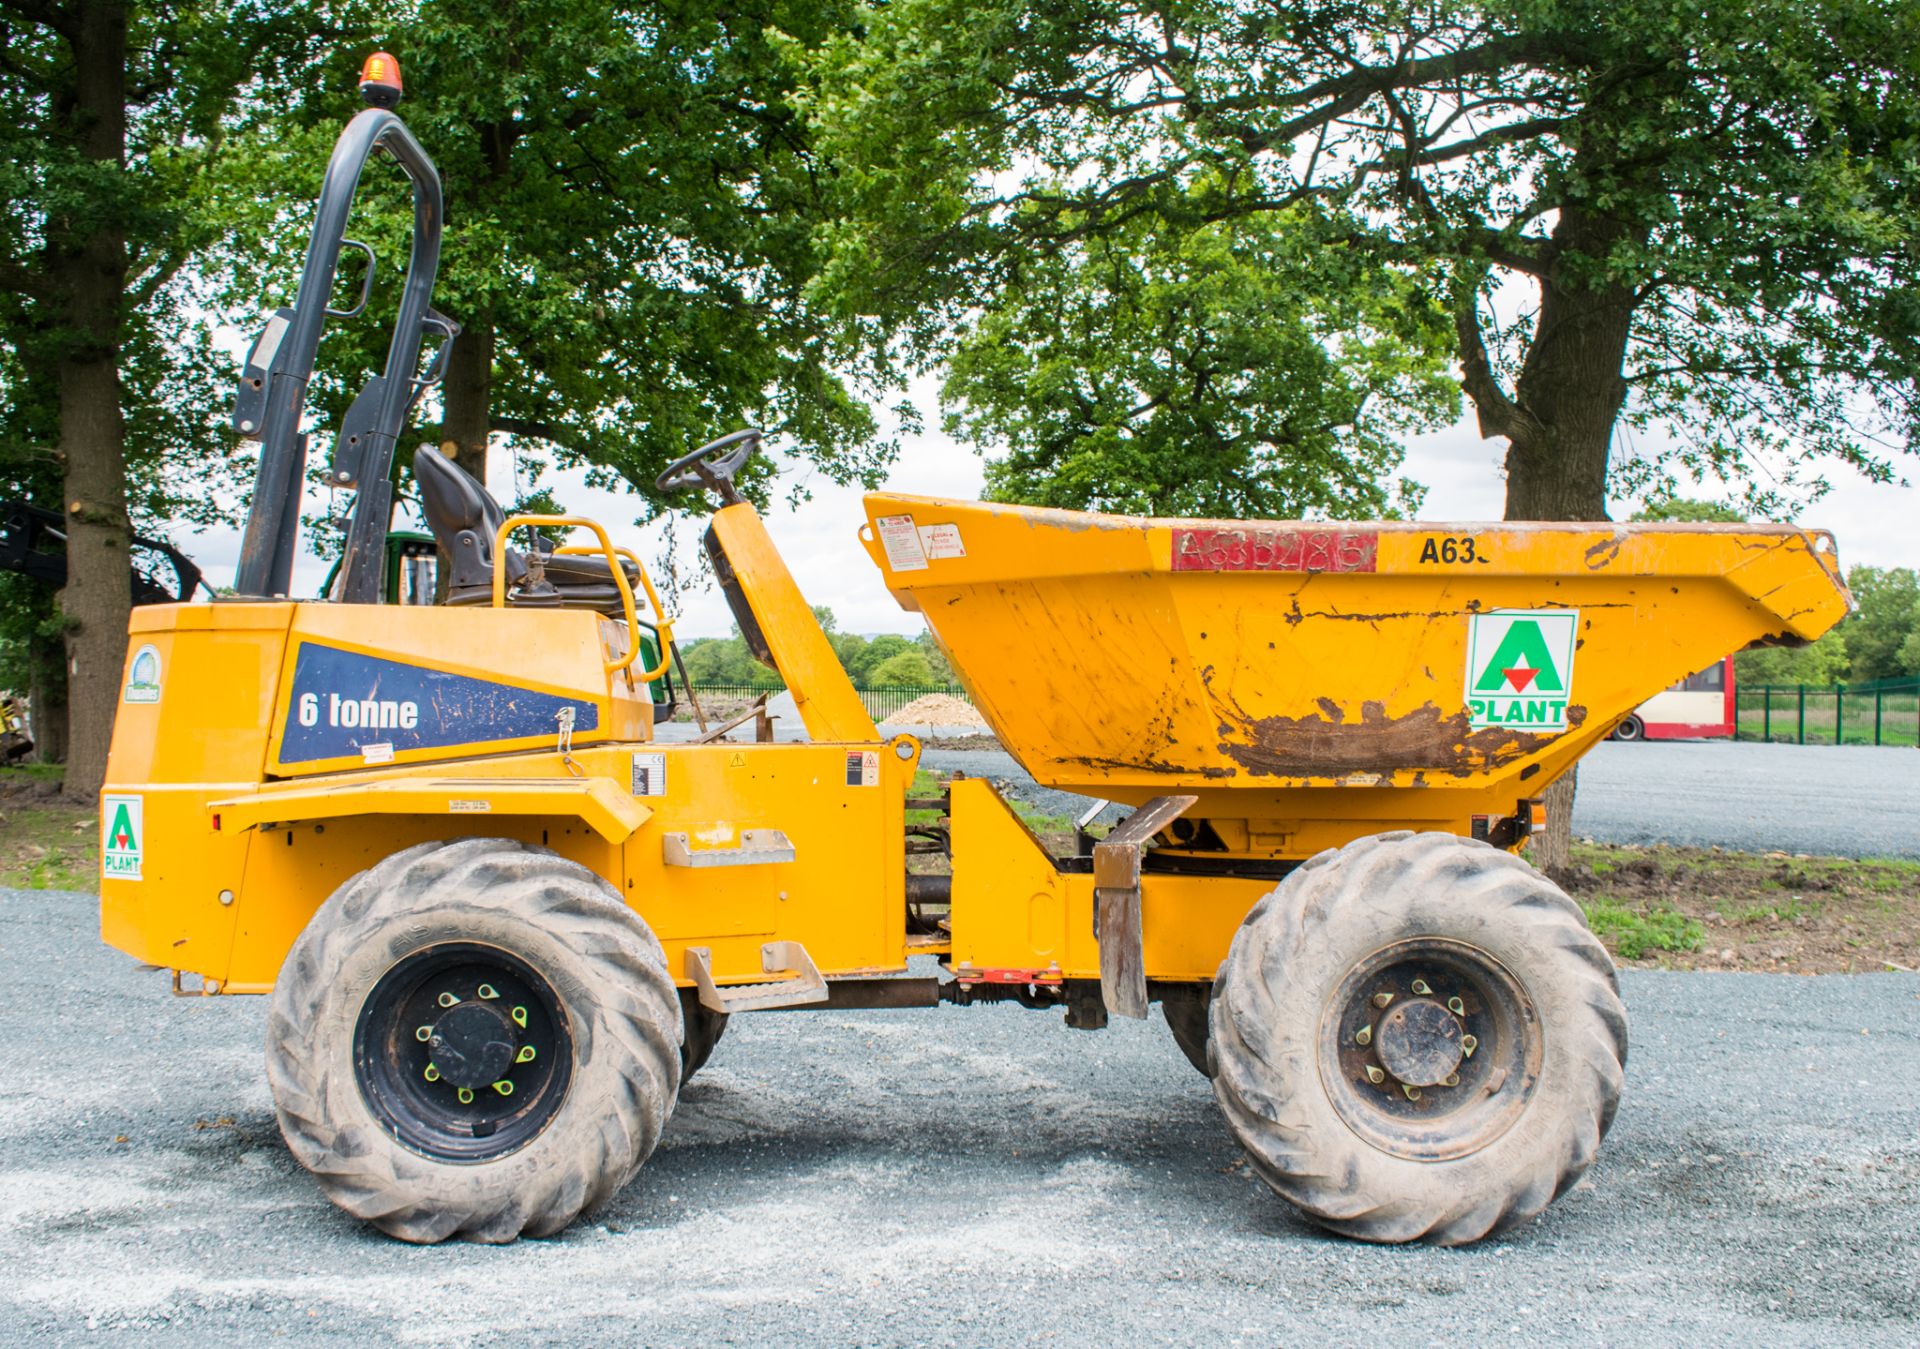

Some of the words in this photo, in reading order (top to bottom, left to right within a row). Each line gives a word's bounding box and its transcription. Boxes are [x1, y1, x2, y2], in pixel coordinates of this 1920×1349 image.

[1420, 537, 1490, 564] A63
[1475, 620, 1564, 691] A
[299, 692, 319, 728] 6
[329, 692, 419, 729] tonne
[1468, 700, 1567, 723] PLANT
[107, 803, 137, 850] A
[105, 855, 140, 872] PLANT
